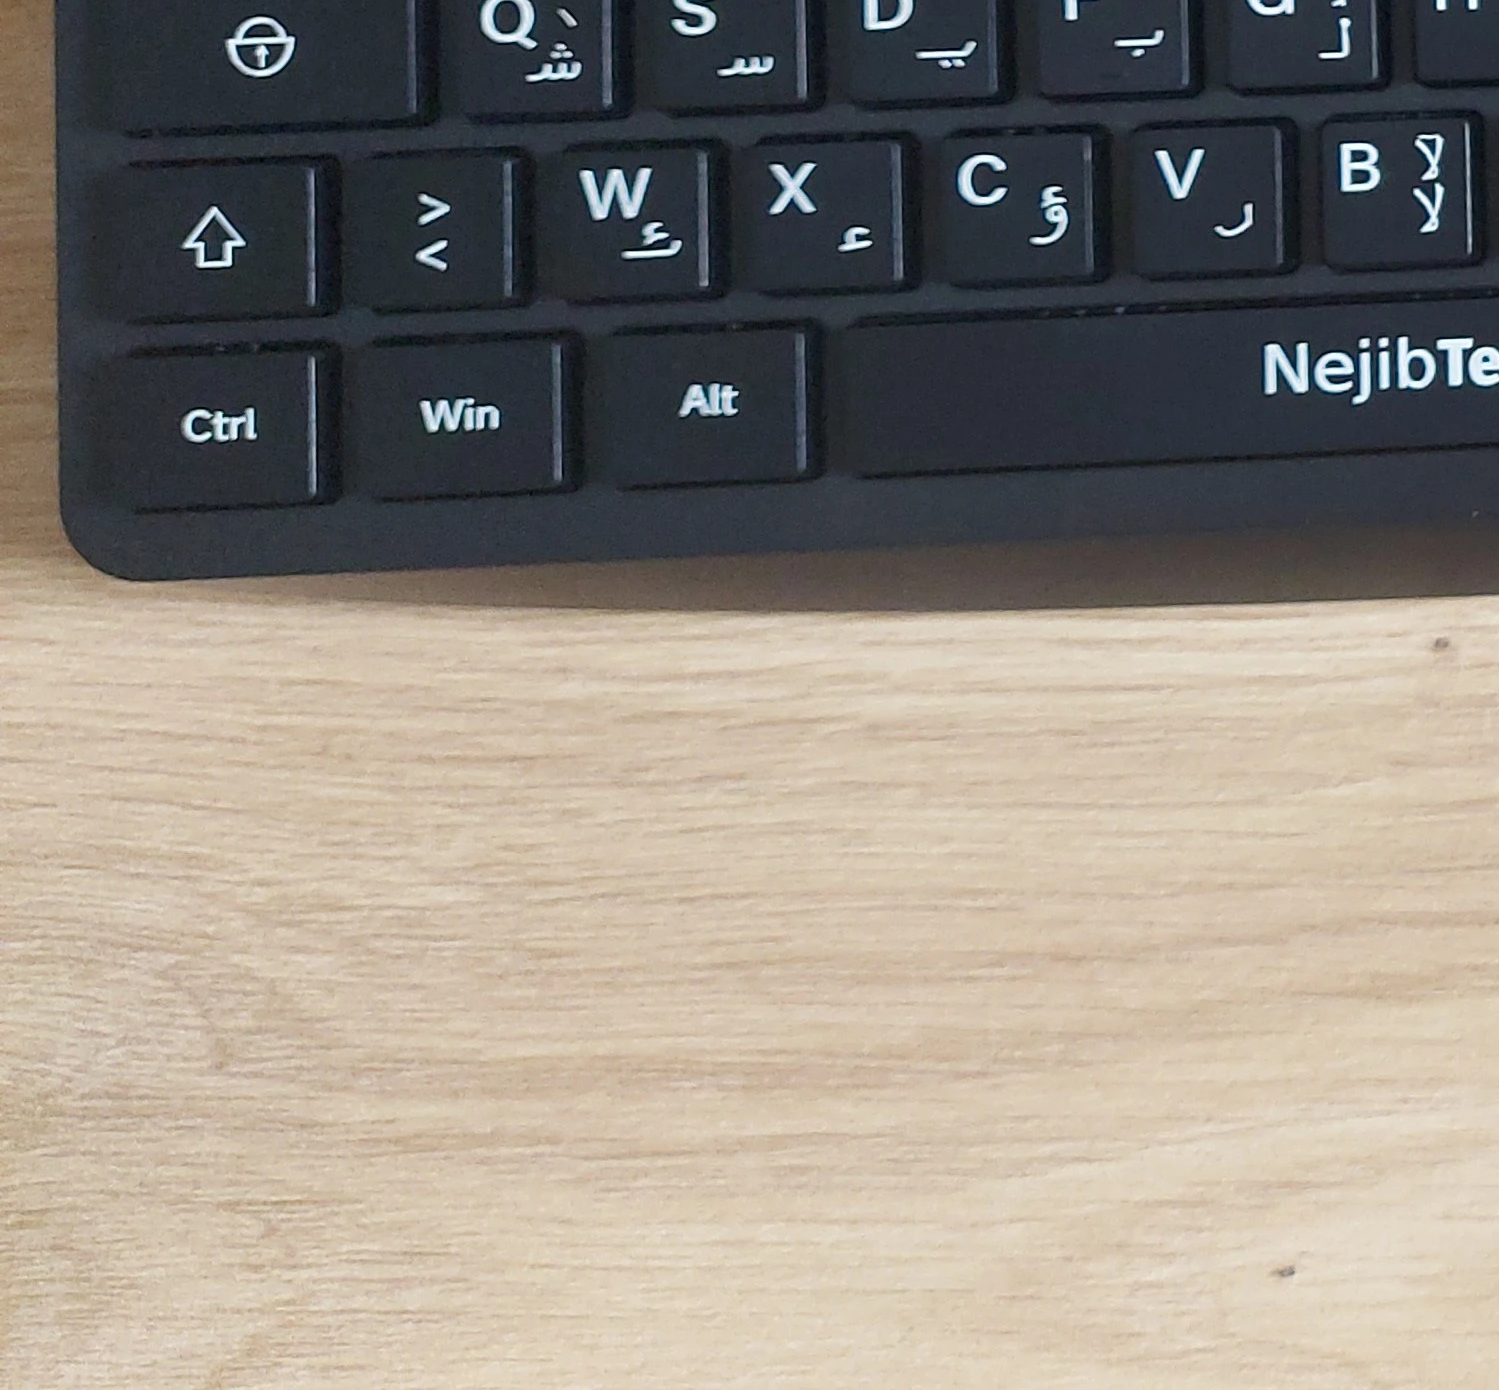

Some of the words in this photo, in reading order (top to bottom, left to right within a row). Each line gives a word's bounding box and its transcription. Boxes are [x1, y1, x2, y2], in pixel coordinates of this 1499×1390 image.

[769, 162, 817, 215] X
[957, 154, 1008, 206] C
[1154, 148, 1205, 200] V
[1340, 142, 1381, 192] B
[579, 167, 652, 221] W
[182, 407, 258, 443] Ctrl
[419, 397, 500, 433] Win
[679, 383, 740, 418] Alt
